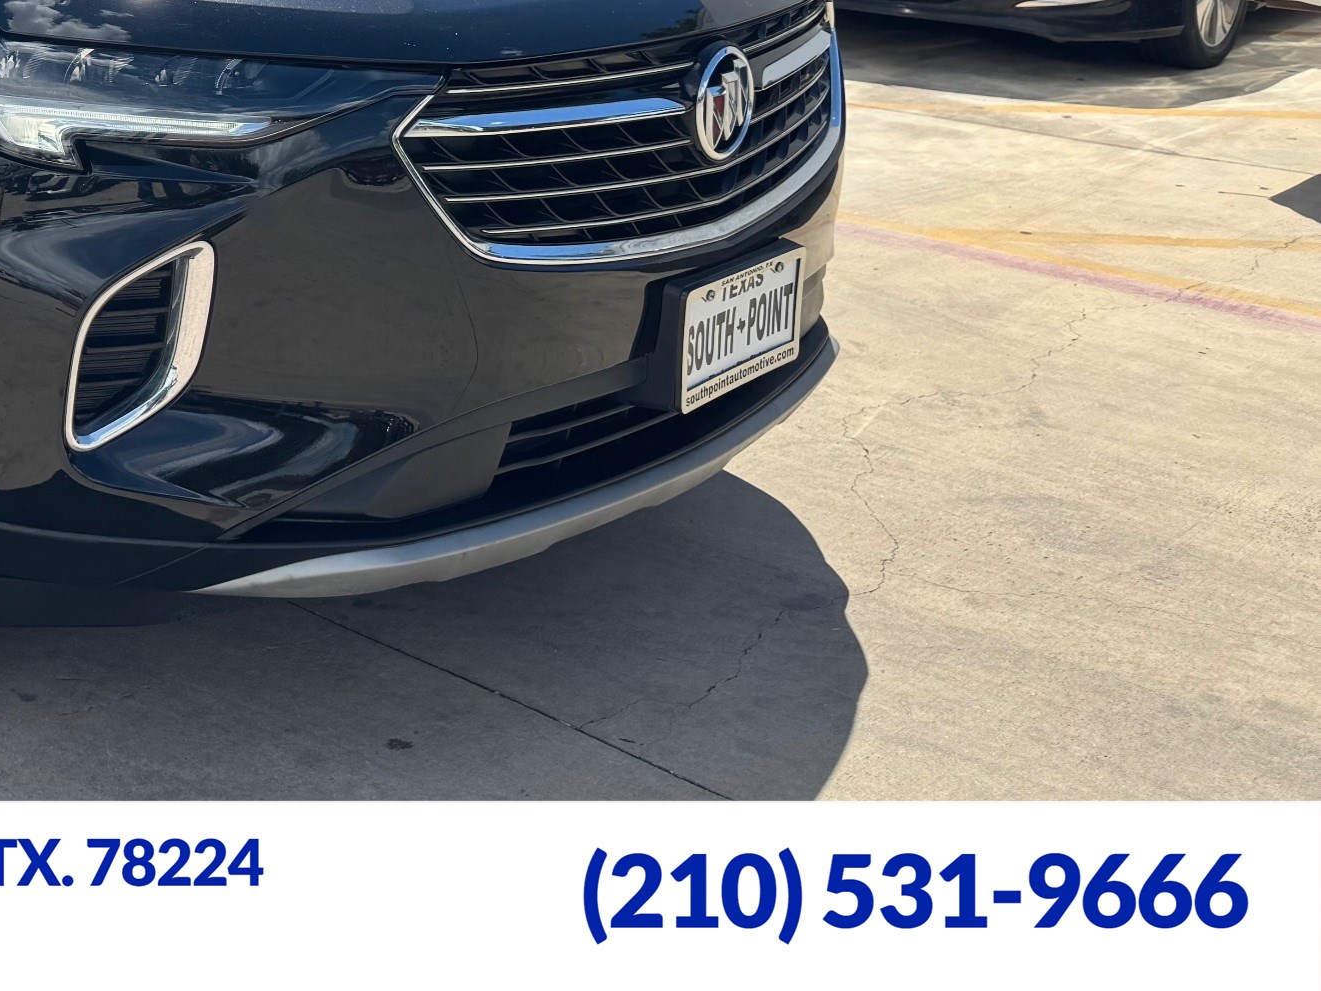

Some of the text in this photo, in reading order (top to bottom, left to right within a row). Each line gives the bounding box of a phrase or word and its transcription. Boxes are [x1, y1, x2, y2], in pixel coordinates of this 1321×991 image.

[722, 273, 764, 302] TEXAS
[687, 282, 794, 376] SOUTH POINT
[686, 347, 795, 407] southpointautomotive.com
